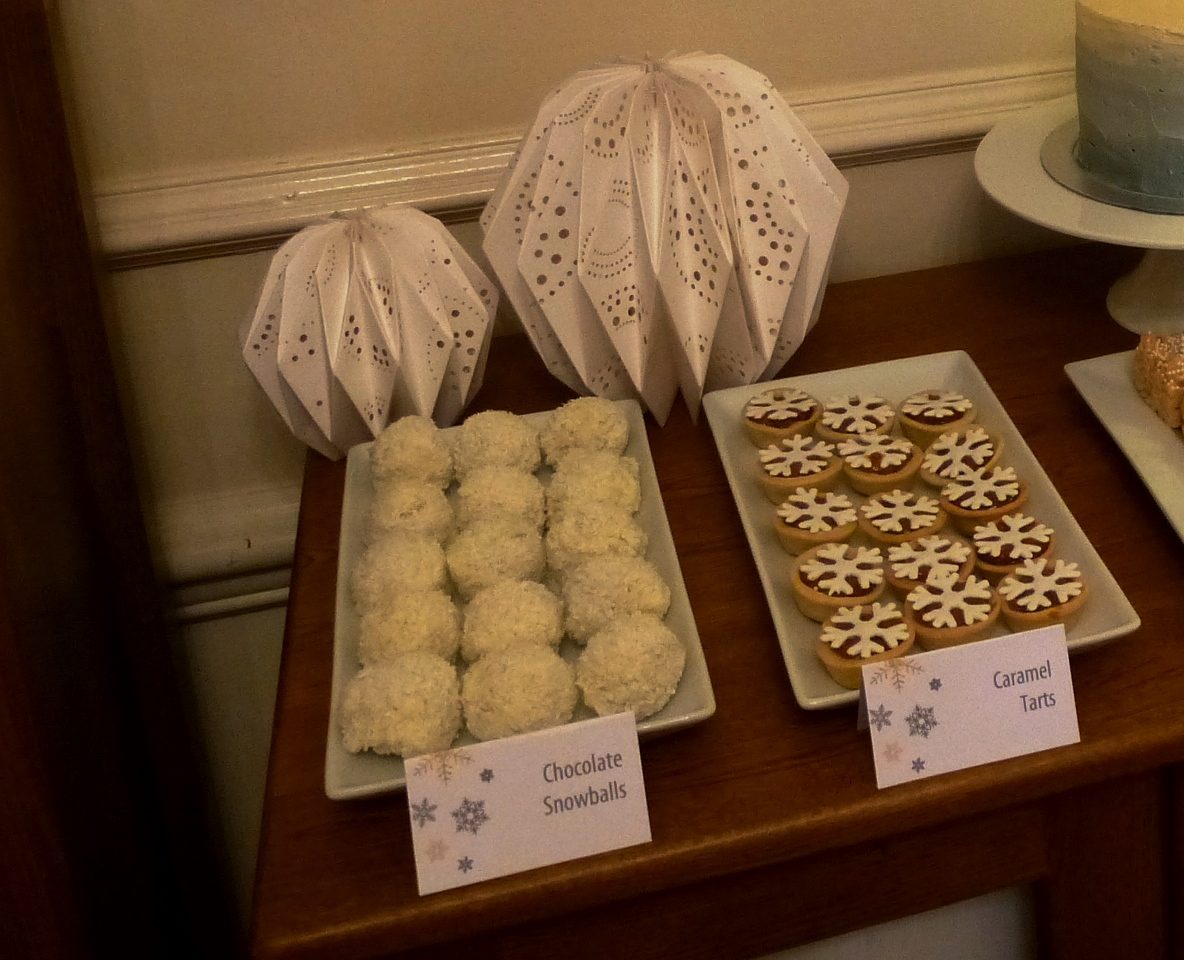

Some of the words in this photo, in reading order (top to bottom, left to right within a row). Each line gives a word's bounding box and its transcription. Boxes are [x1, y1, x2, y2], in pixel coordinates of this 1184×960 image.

[993, 659, 1052, 689] Caramel
[1020, 691, 1056, 713] Tarts
[543, 751, 623, 783] Chocolate
[543, 780, 627, 816] Snowballs
